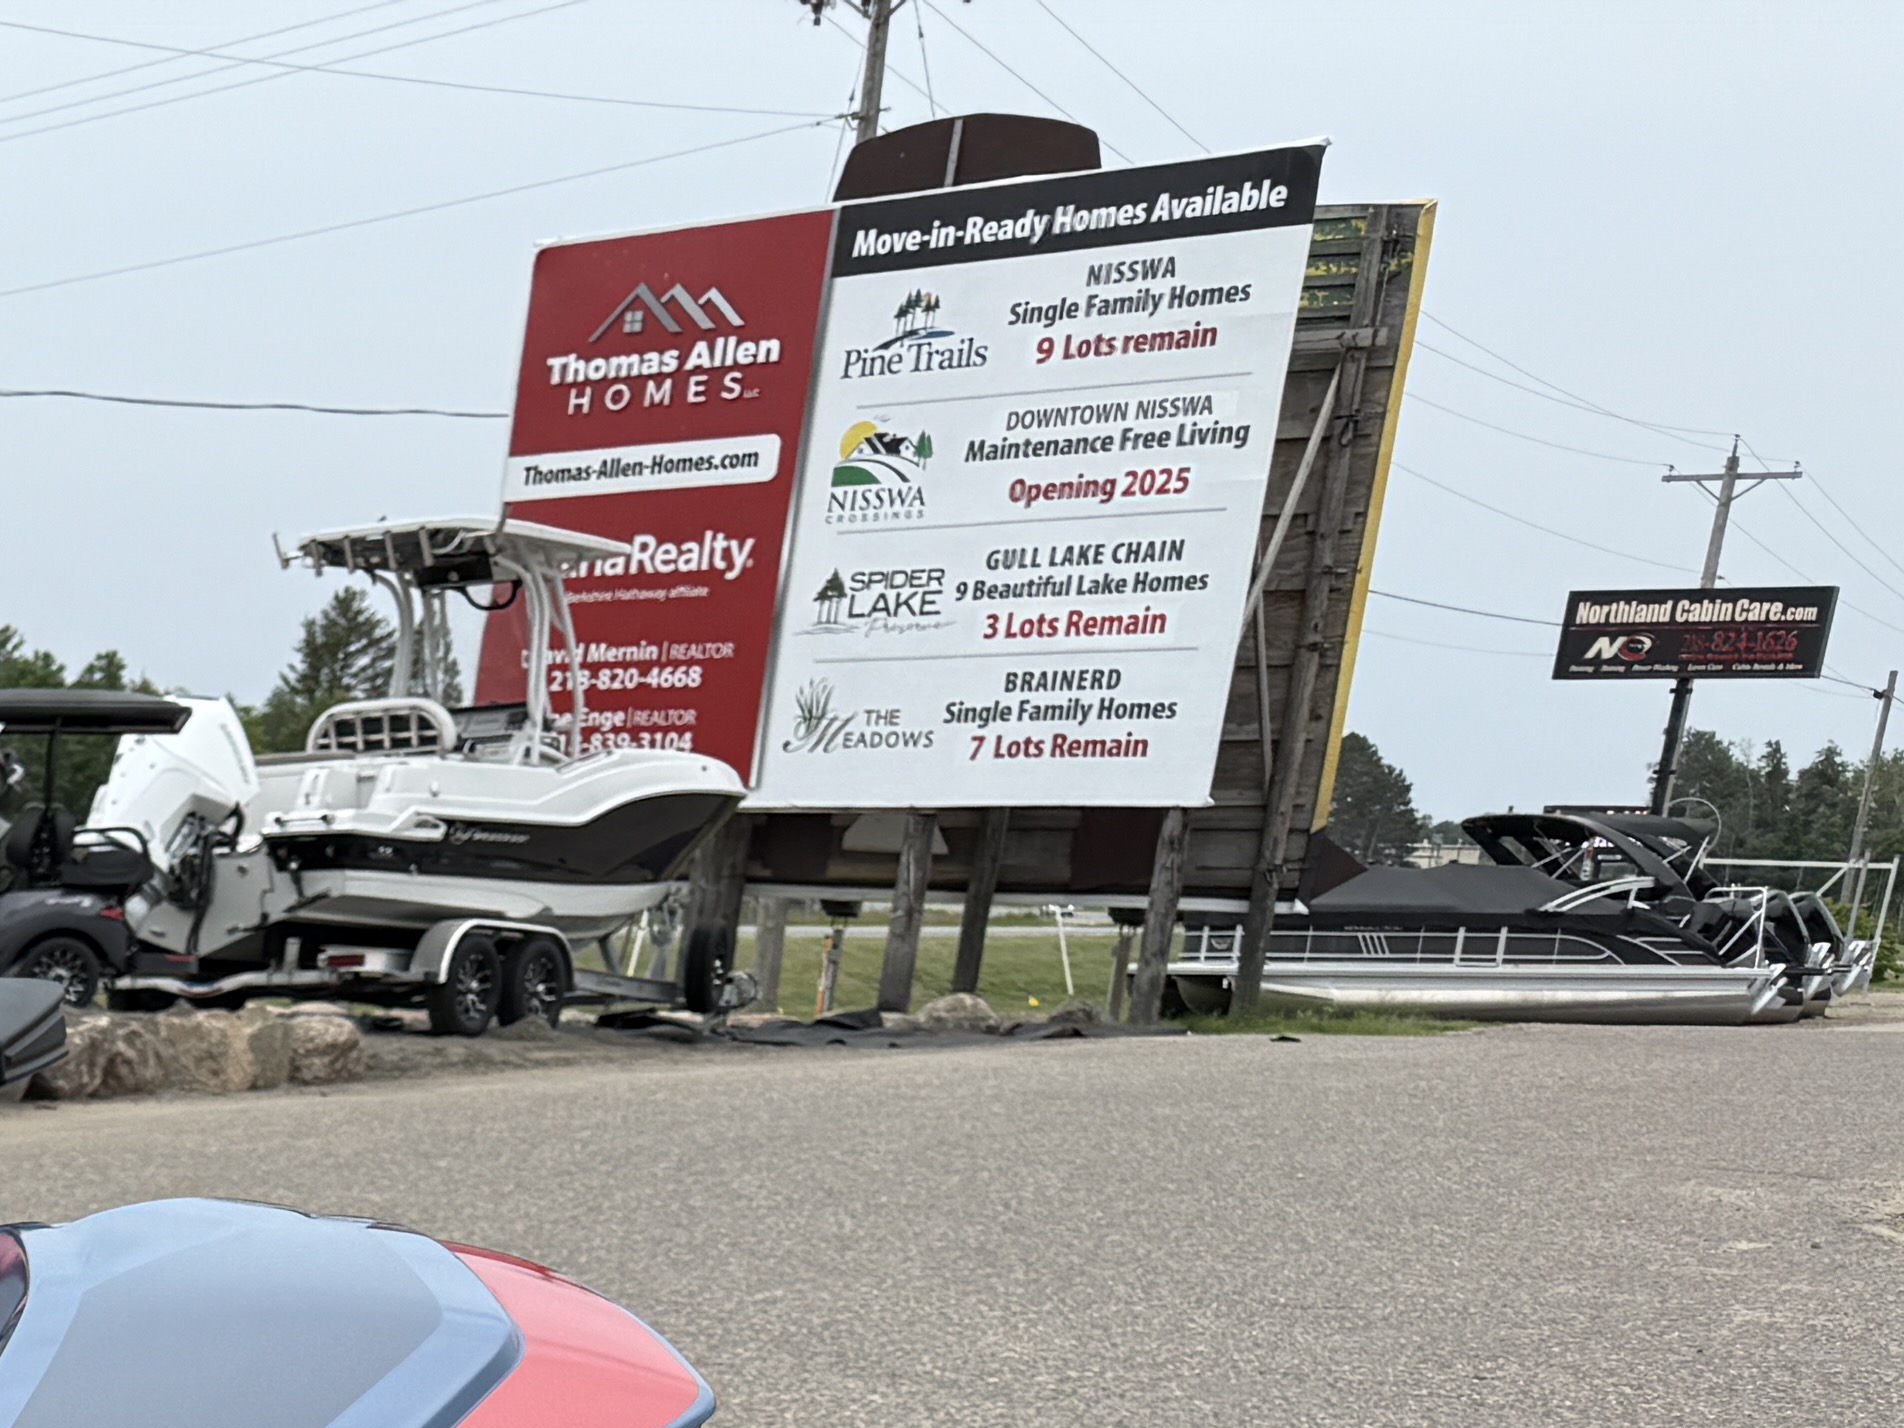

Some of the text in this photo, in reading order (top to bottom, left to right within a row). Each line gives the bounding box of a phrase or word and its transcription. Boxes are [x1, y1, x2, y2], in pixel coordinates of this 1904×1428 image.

[852, 179, 1288, 258] Move-in-Ready Homes Available
[1085, 256, 1176, 287] NISSWA
[1008, 282, 1252, 328] Single Family Homes
[840, 338, 988, 379] Pine Trails
[1035, 322, 1218, 364] 9 Lots remain
[546, 336, 781, 386] Thomas Allen
[567, 372, 743, 415] HOMES
[1006, 394, 1213, 432] DOWNTOWN NISSWA
[964, 420, 1251, 463] Maintenance Free Living
[523, 451, 759, 487] Thomas-Allen-Homes.com
[827, 485, 926, 514] NISSWA
[1008, 467, 1191, 509] Opening 2025
[824, 509, 925, 525] CROSSINGS
[985, 539, 1185, 571] GULL LAKE CHAIN
[849, 568, 945, 592] SPIDER
[954, 569, 1209, 602] 9 Beautiful Lake Homes
[848, 590, 943, 619] LAKE
[1576, 600, 1674, 624] Northland
[982, 606, 1167, 639] 3 Lots Remain
[587, 640, 659, 662] Mernin
[1004, 669, 1122, 694] BRAINERD
[864, 708, 902, 727] THE
[943, 697, 1178, 728] Single Family Homes
[969, 732, 1149, 760] 7 Lots Remain
